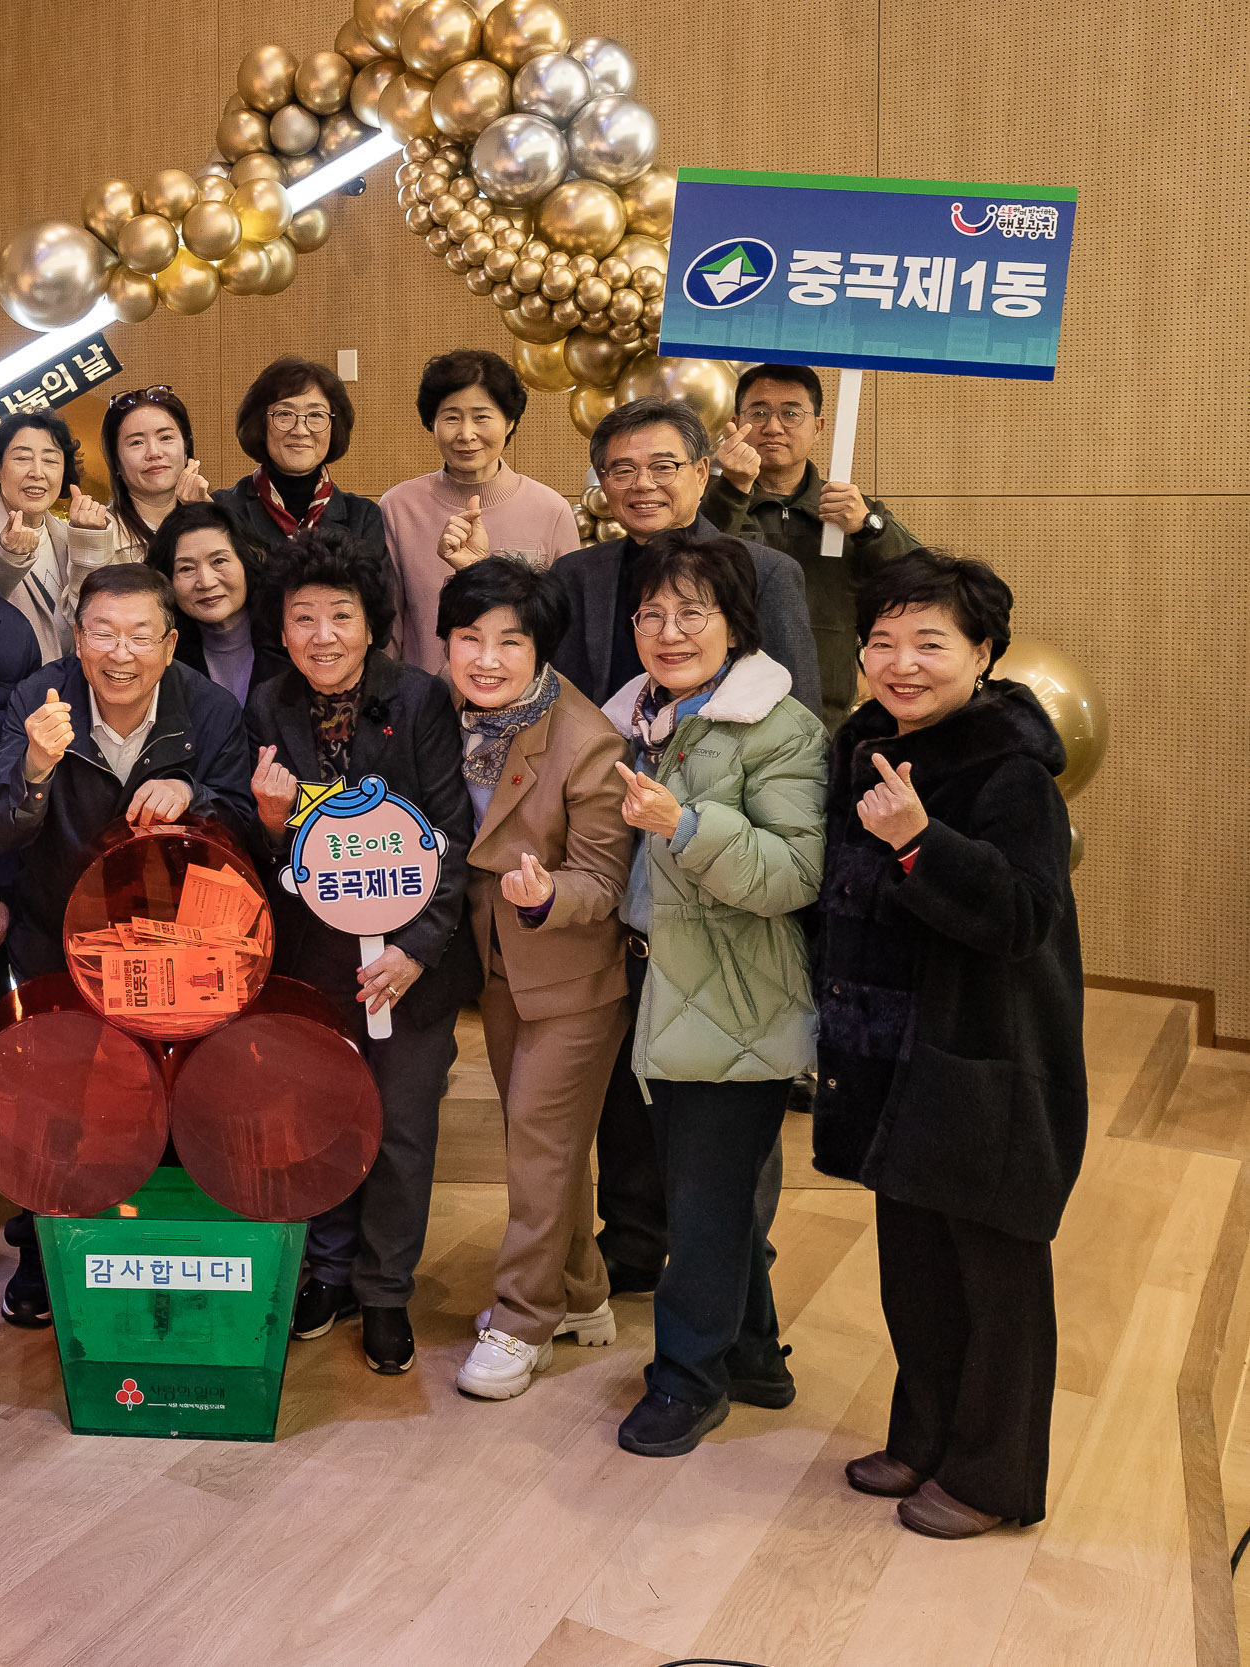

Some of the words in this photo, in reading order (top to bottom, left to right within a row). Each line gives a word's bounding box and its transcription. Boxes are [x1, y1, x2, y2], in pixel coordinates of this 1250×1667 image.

[998, 217, 1055, 238] 행복광진
[786, 248, 1048, 318] 중곡제1동
[72, 343, 112, 382] 날
[317, 866, 423, 901] 중곡제1동
[125, 989, 133, 1007] 2026
[132, 958, 148, 1008] 따뜻한
[89, 1258, 246, 1285] 감사합니다!
